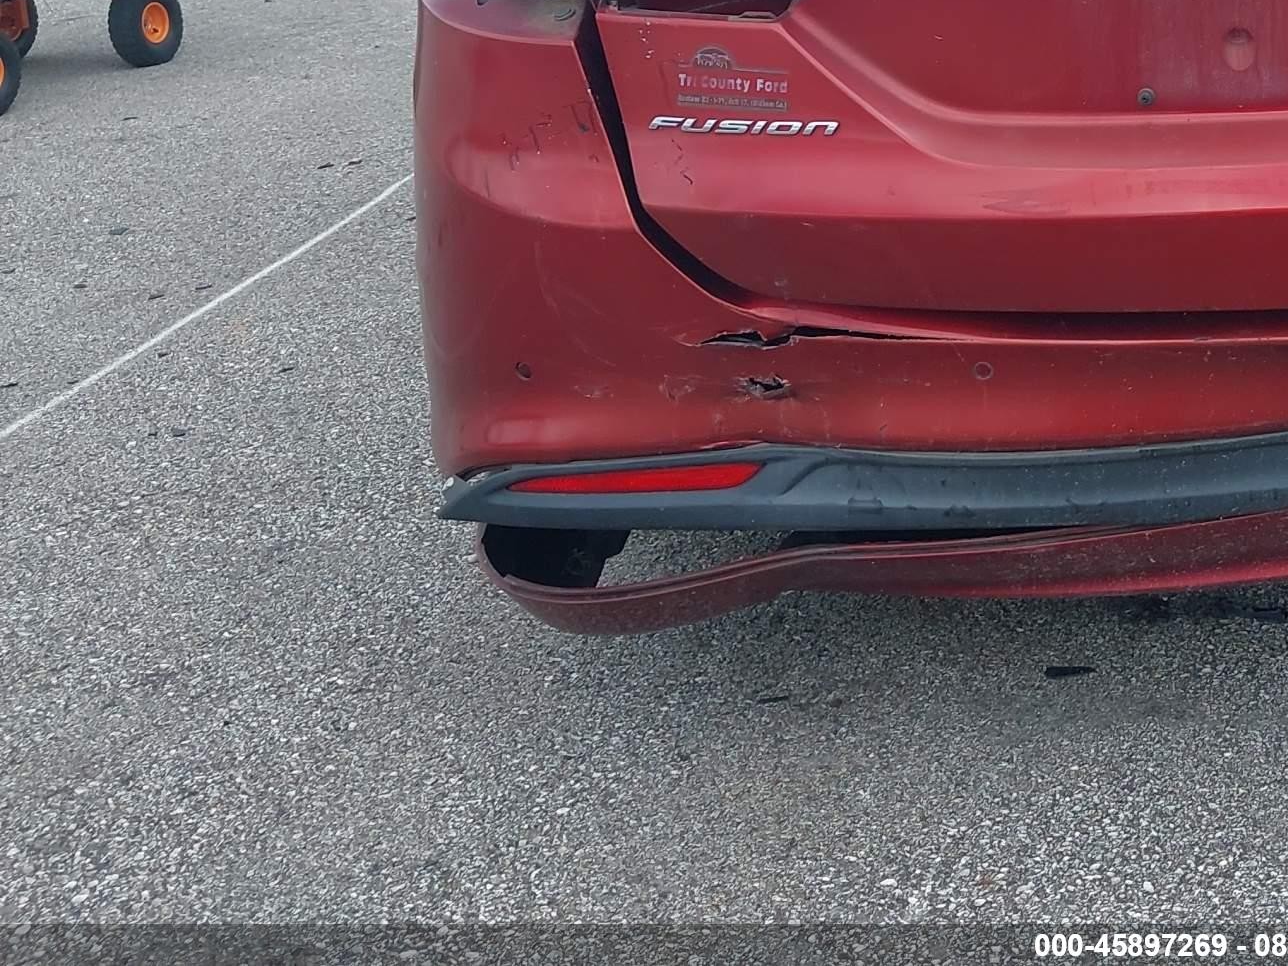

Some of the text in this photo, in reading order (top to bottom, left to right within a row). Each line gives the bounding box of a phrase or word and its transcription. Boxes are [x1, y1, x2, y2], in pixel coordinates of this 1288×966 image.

[701, 75, 751, 94] County
[756, 78, 788, 94] Ford
[648, 115, 840, 136] FUSION
